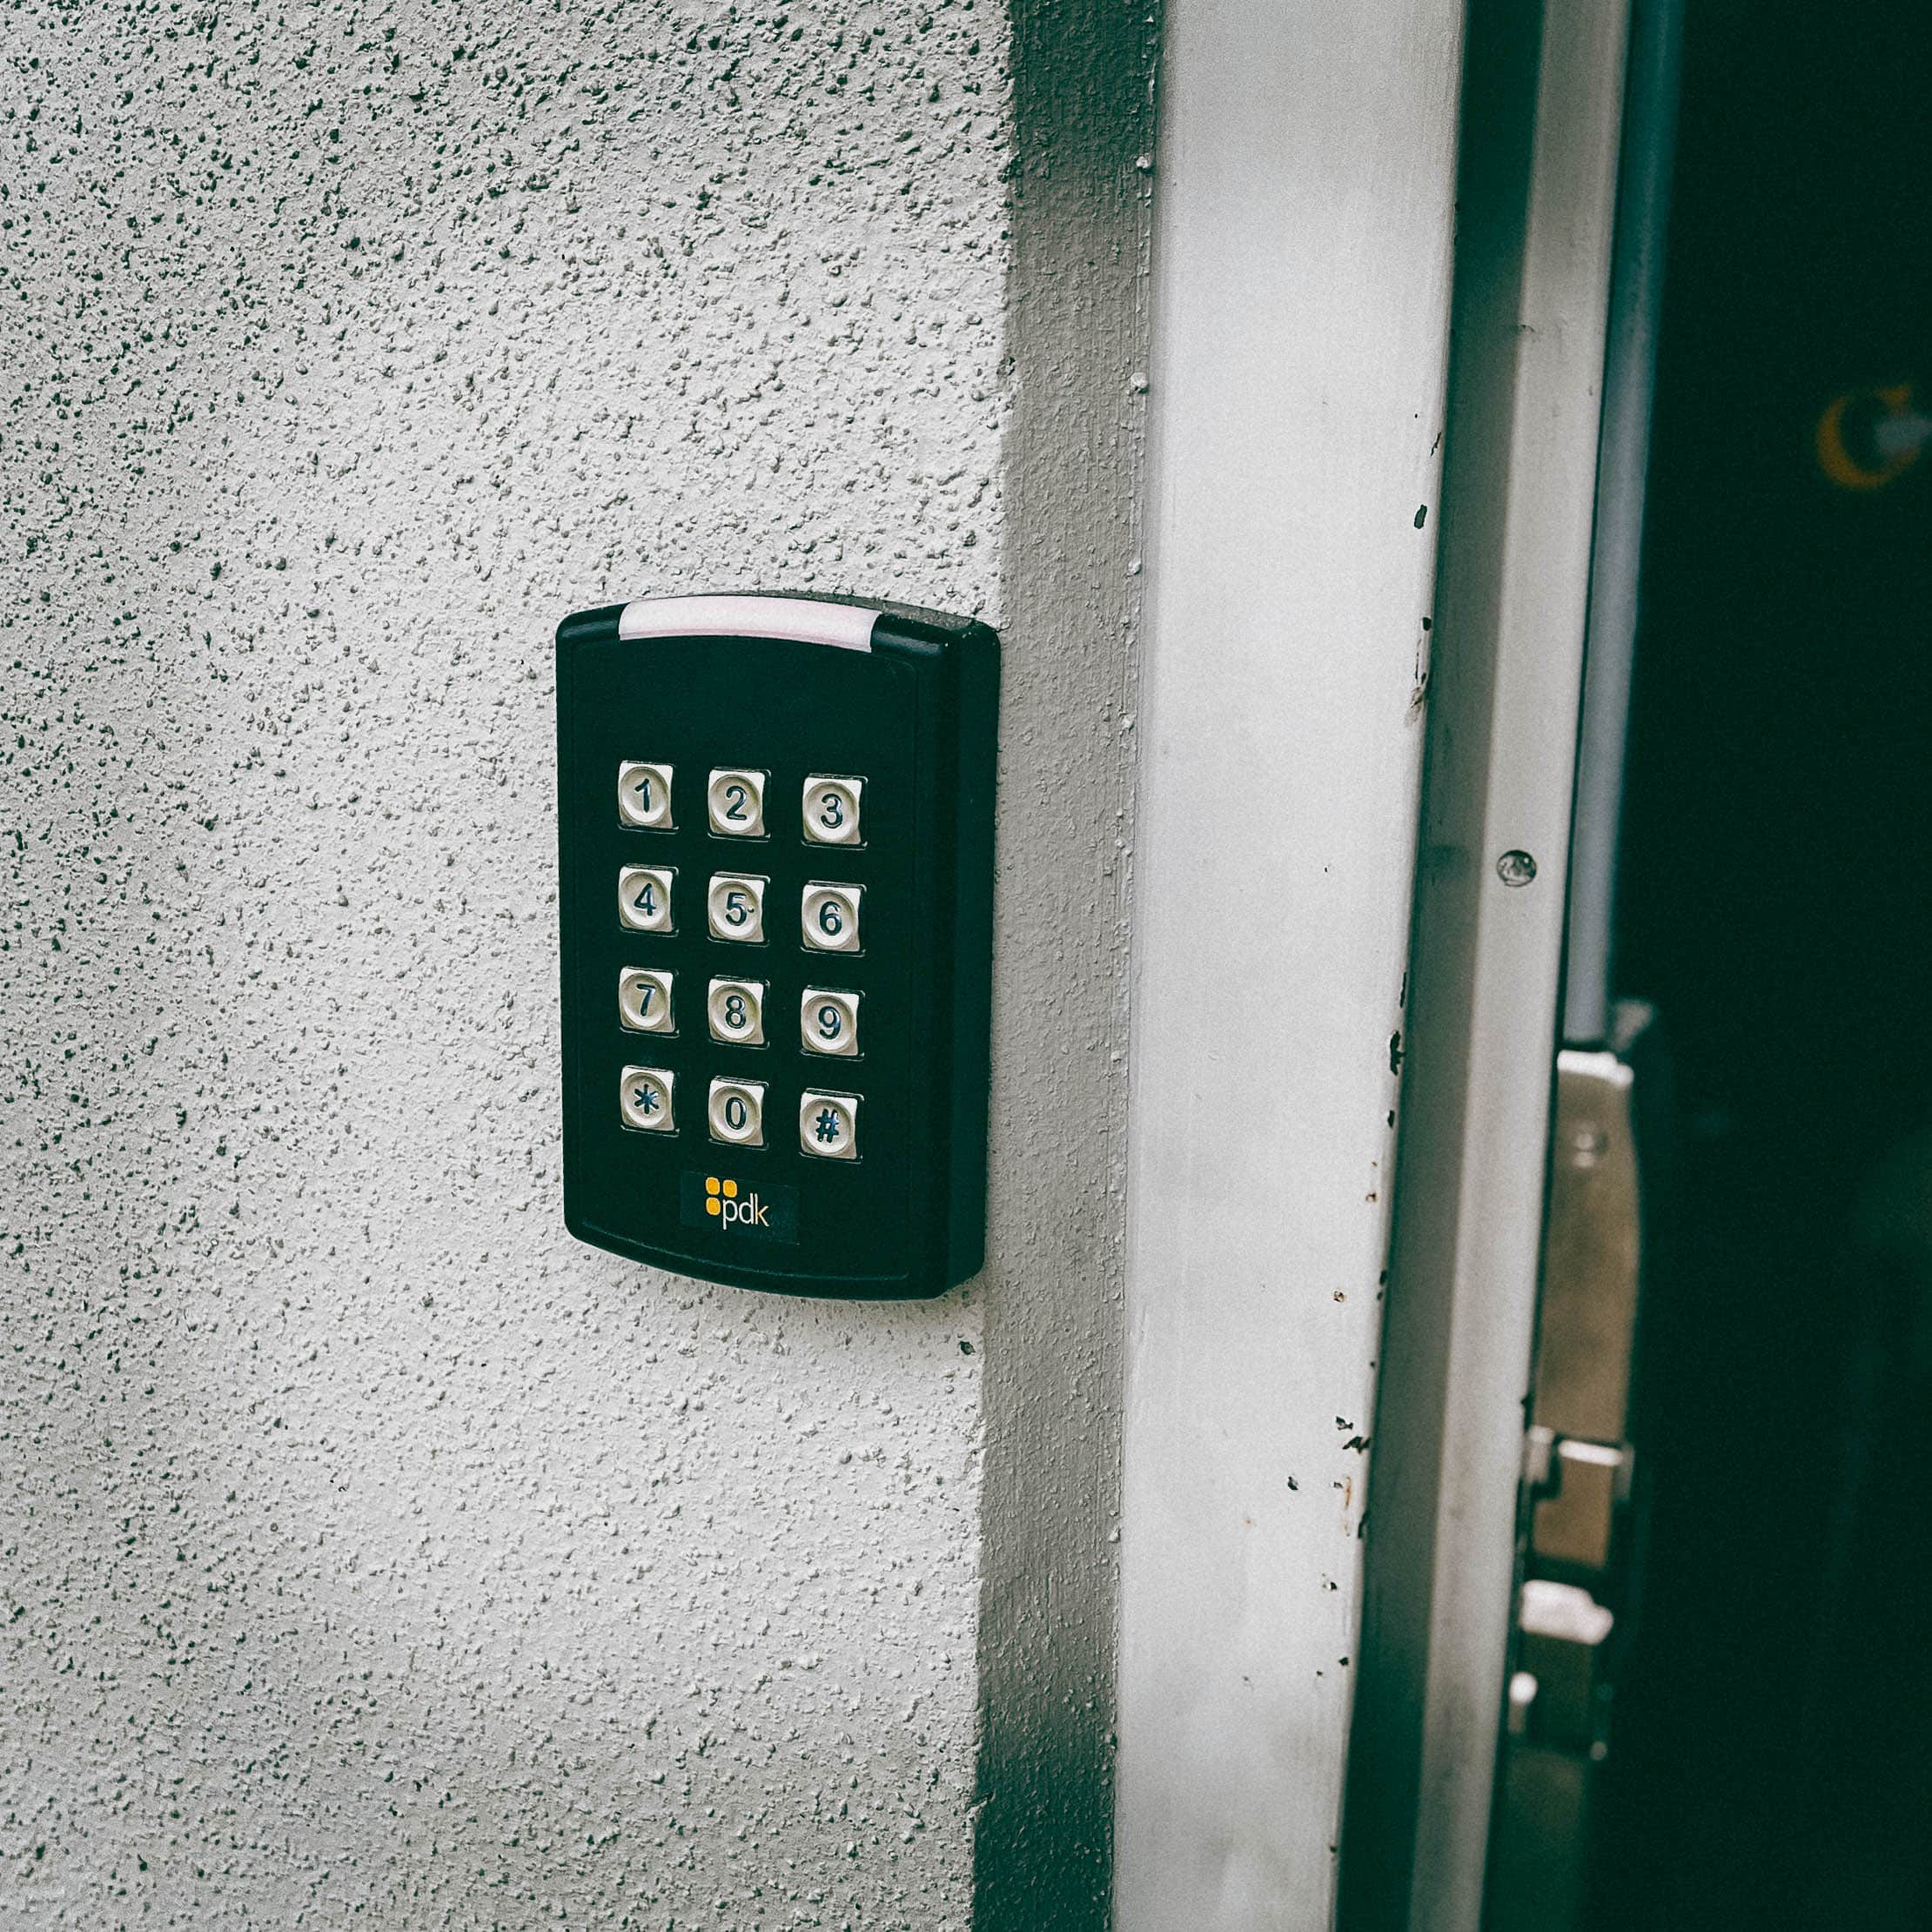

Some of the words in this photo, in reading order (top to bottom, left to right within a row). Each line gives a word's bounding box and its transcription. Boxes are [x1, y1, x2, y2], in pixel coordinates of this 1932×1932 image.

[634, 779, 649, 813] 1
[726, 785, 747, 821] 2
[821, 793, 843, 828] 3
[634, 882, 656, 916] 4
[726, 892, 747, 926] 5
[819, 901, 842, 936] 6
[636, 983, 655, 1016] 7
[725, 995, 746, 1029] 8
[818, 1005, 841, 1039] 9
[725, 1097, 746, 1130] 0
[722, 1192, 768, 1230] pdk
